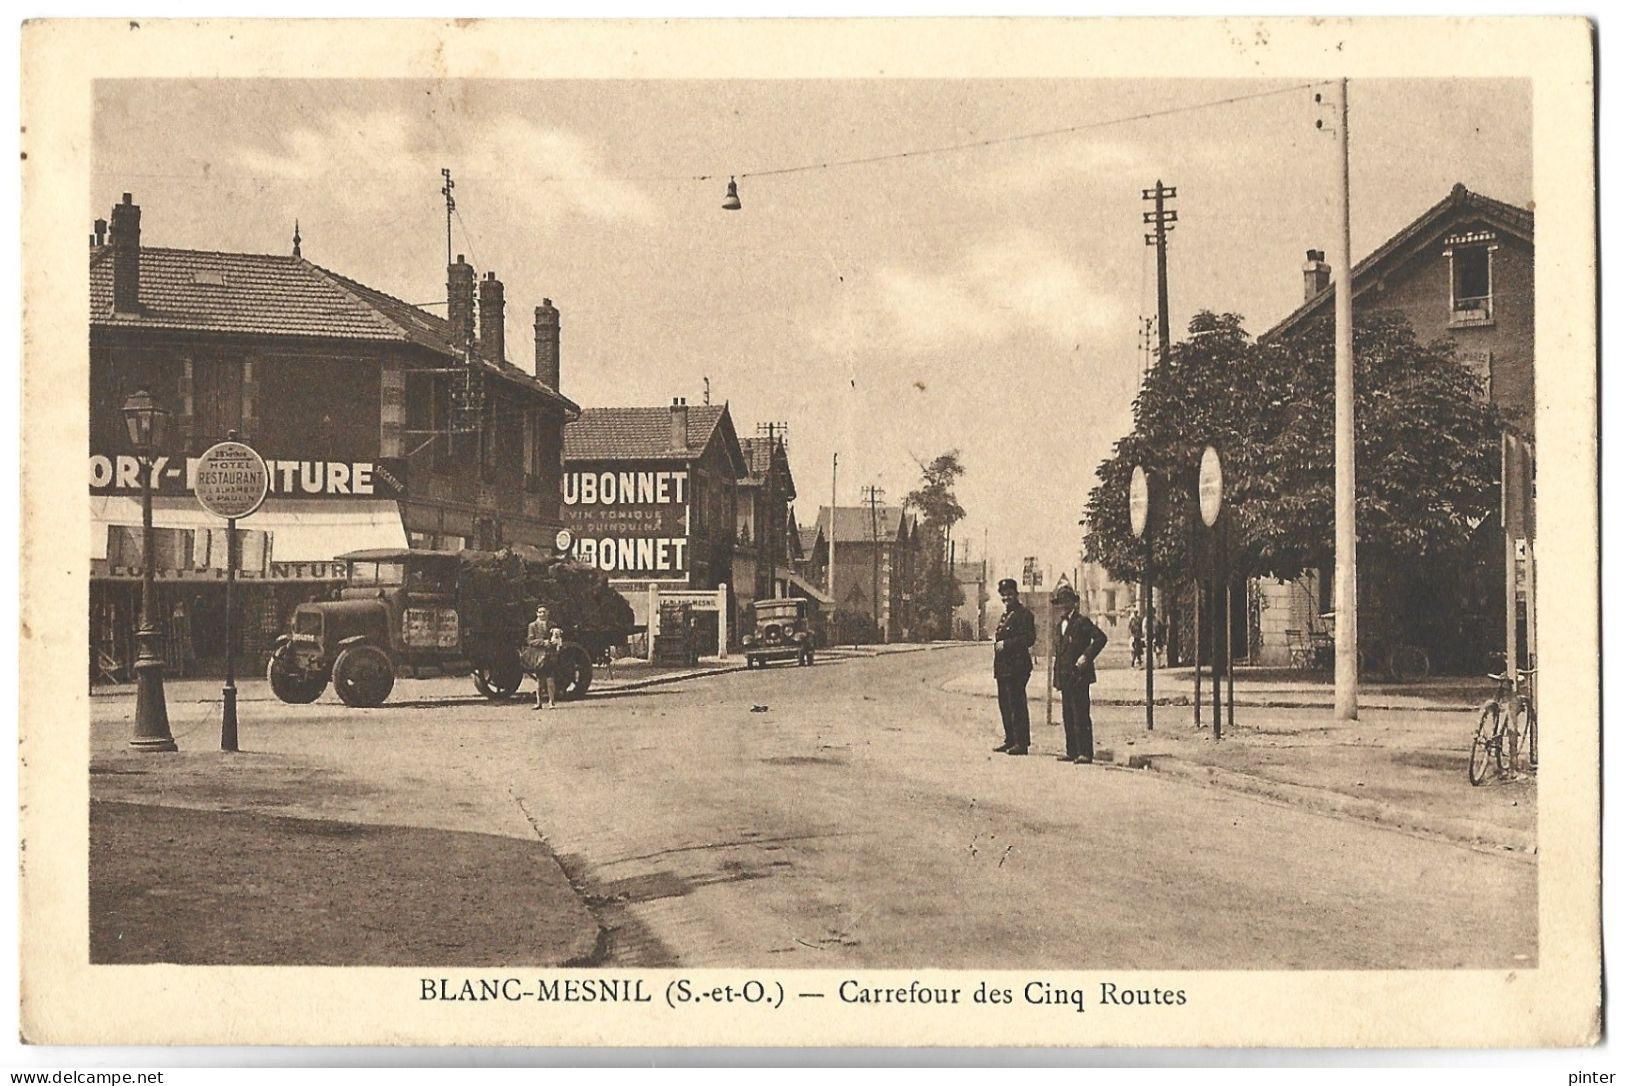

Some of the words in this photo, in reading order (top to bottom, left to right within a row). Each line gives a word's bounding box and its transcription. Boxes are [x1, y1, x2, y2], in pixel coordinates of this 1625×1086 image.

[199, 472, 262, 485] RESTAURANT
[569, 510, 593, 519] VIN
[600, 510, 663, 520] TONIQUE
